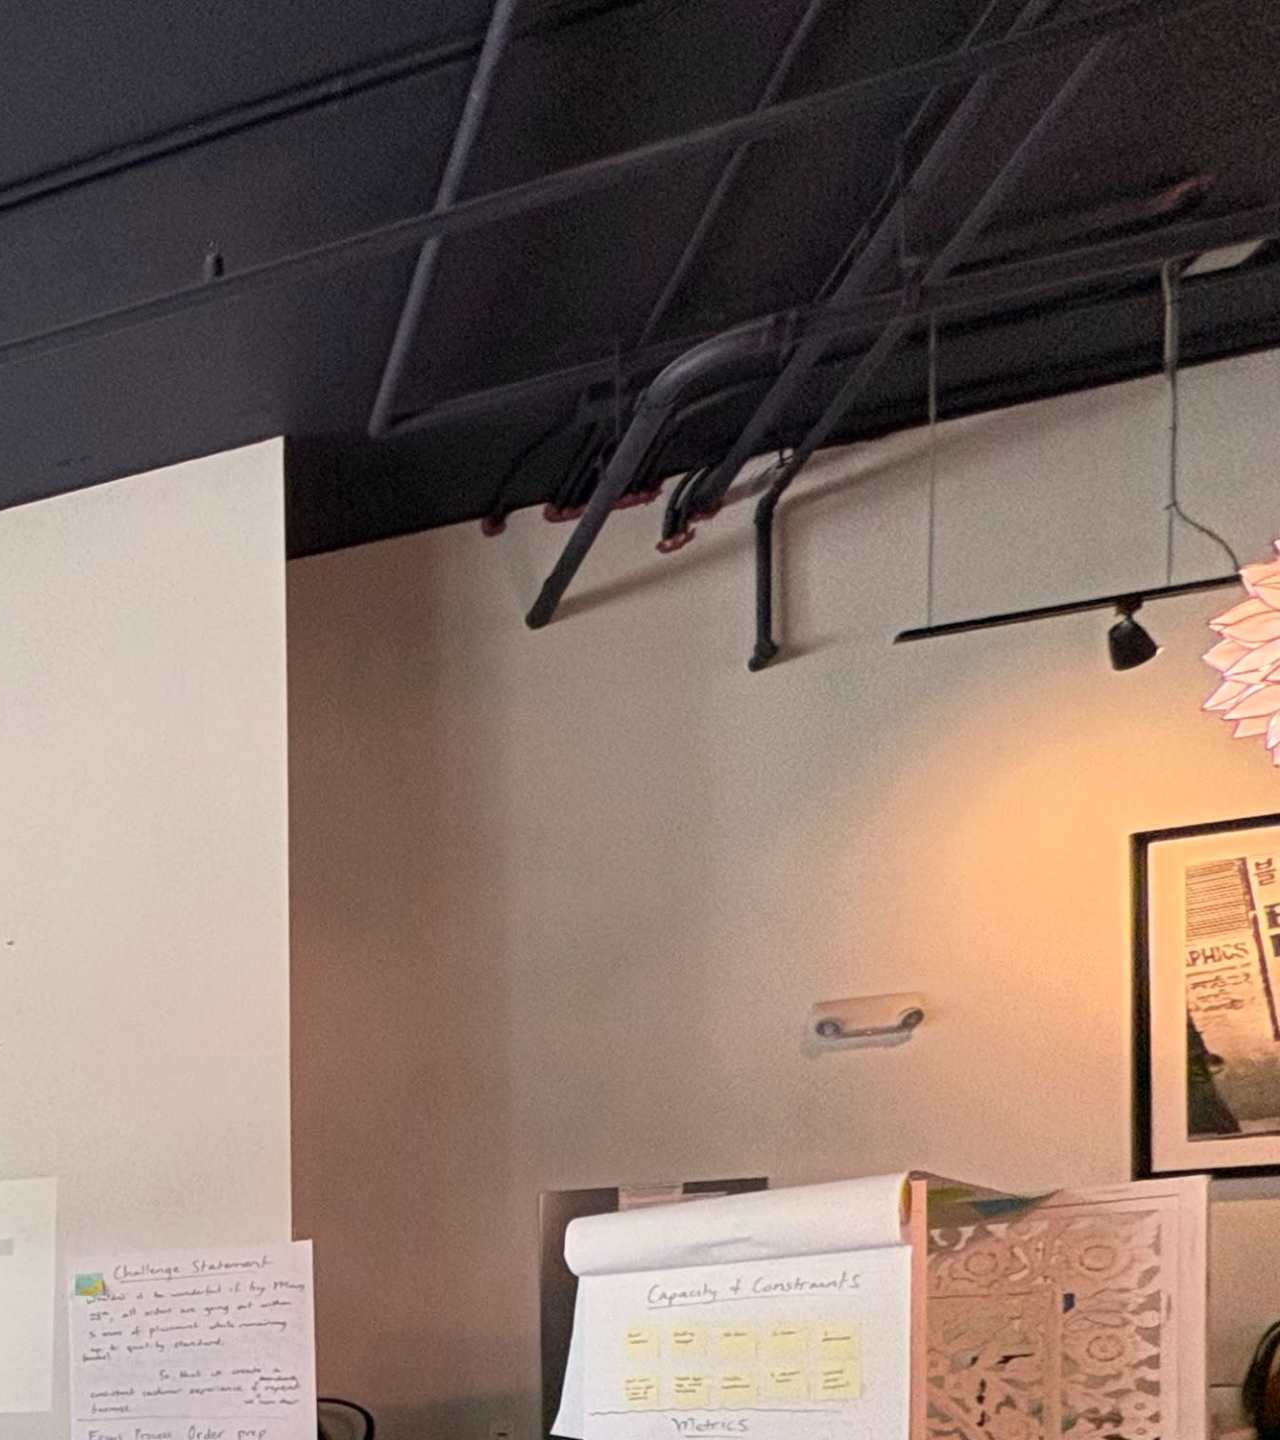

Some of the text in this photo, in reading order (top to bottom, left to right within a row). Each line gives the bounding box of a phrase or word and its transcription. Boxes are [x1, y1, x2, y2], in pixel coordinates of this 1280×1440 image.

[113, 1257, 273, 1281] Challenge Statement
[188, 1425, 225, 1440] Order
[671, 1417, 750, 1433] Metrics
